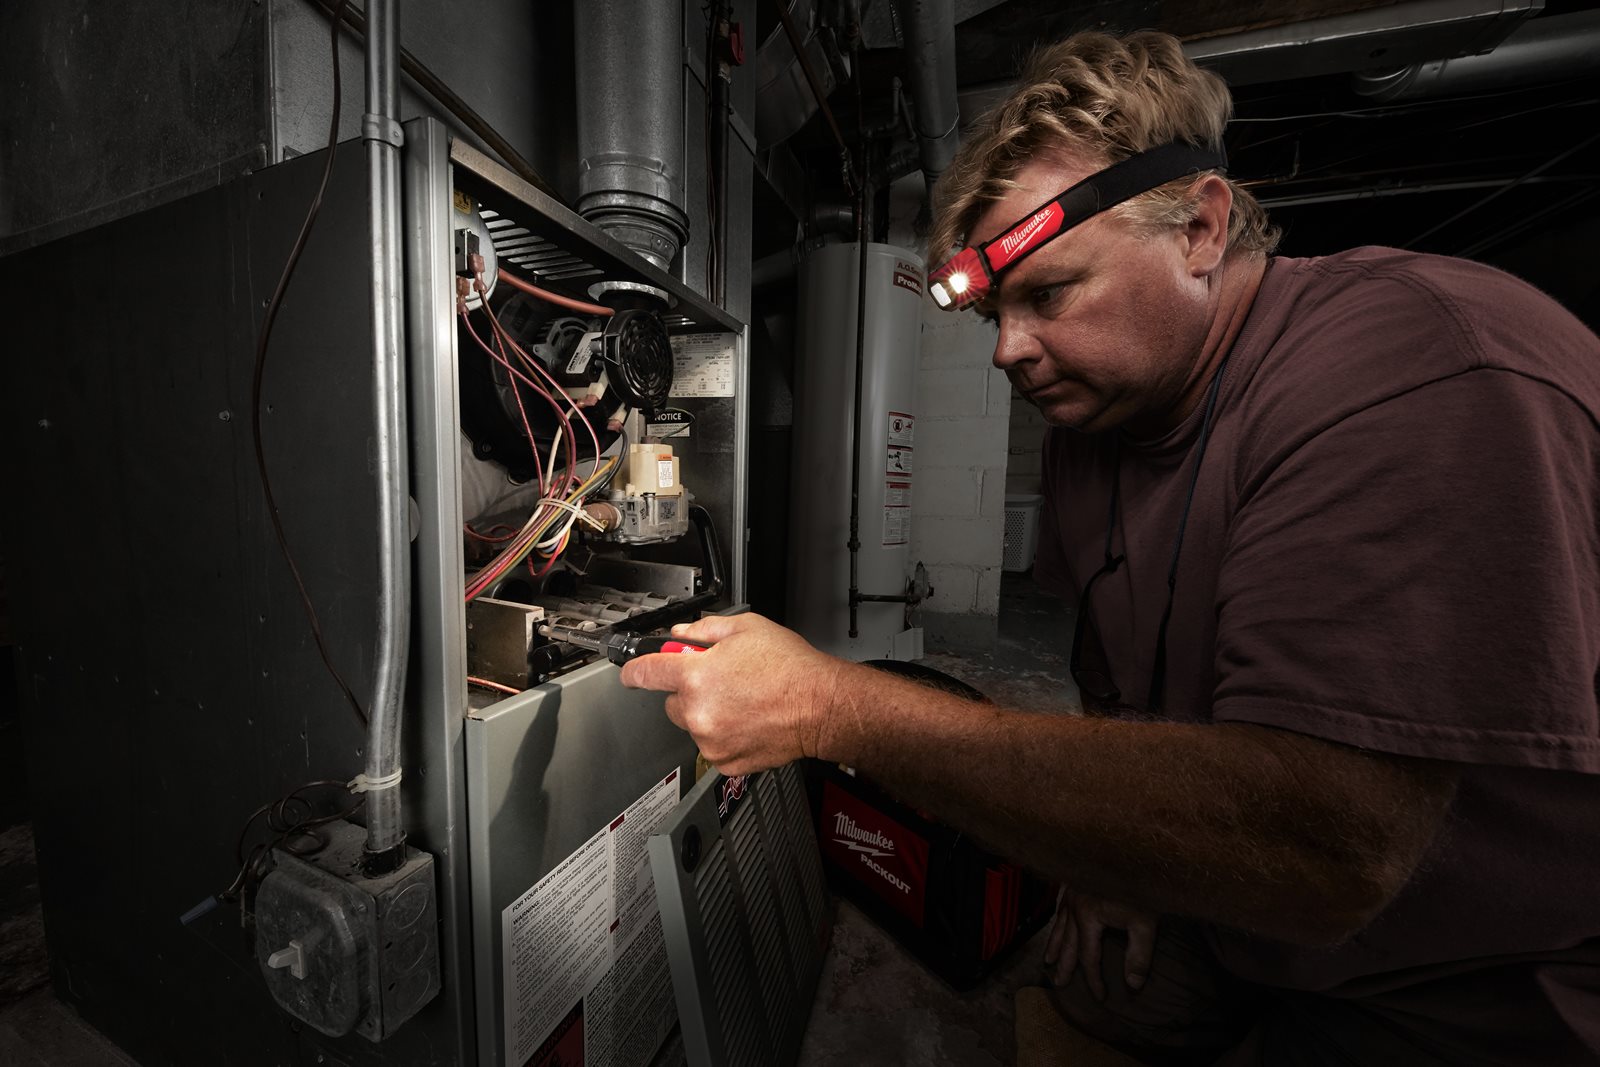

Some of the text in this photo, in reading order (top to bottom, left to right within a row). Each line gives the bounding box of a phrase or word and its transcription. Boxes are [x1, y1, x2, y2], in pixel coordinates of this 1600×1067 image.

[1000, 209, 1051, 254] Milwaukee
[834, 811, 895, 850] Milwaukee
[512, 829, 606, 913] FOR YOUR SAFETY READ BEFORE OPERATING
[861, 853, 911, 894] PACKOUT
